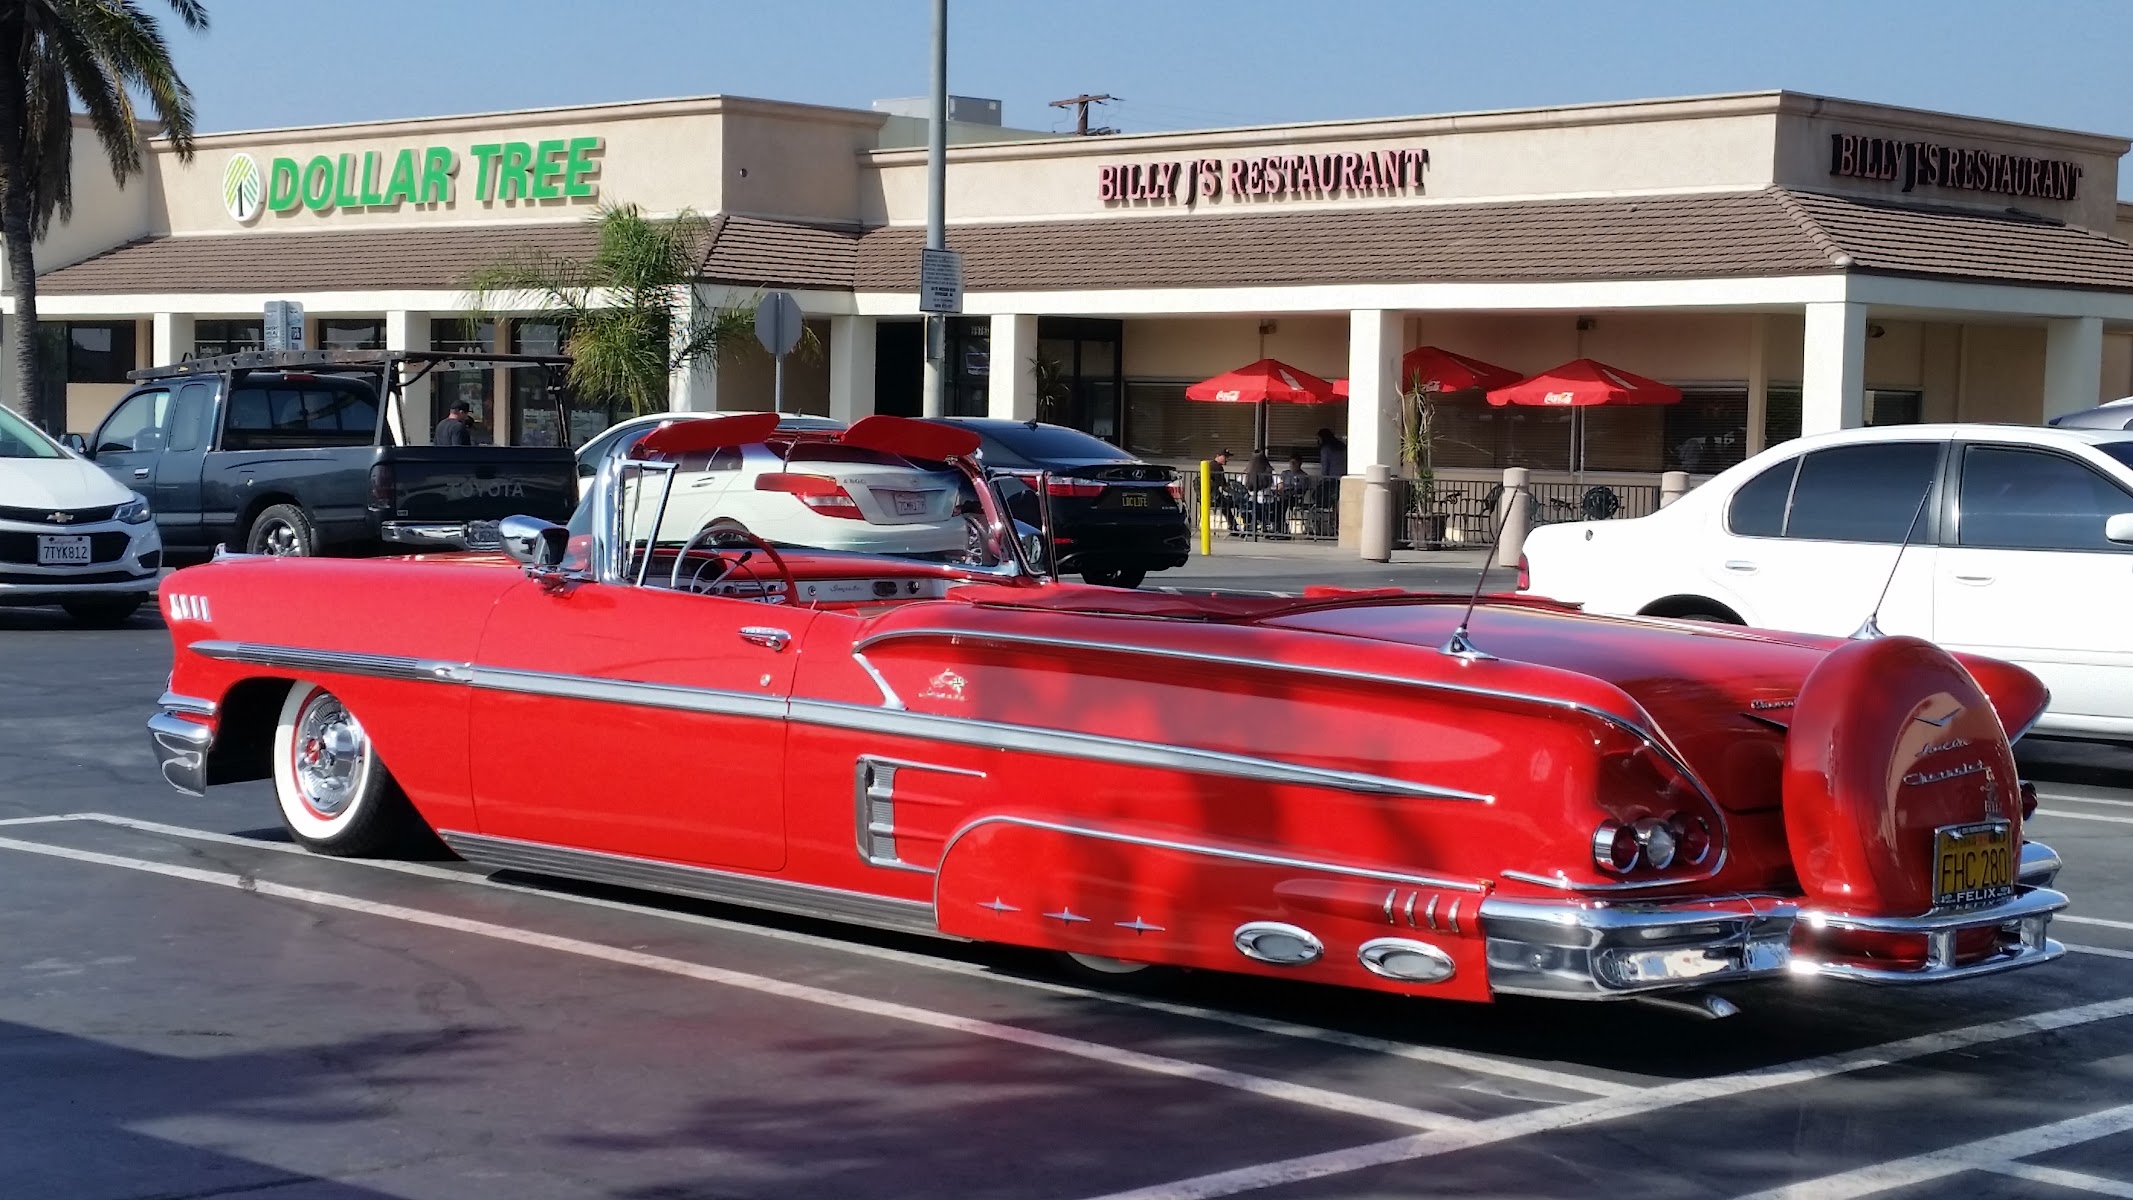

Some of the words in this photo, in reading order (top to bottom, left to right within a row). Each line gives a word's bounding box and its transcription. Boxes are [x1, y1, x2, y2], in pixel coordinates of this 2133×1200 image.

[268, 146, 456, 213] DOLLAR
[471, 136, 600, 202] TREE
[1098, 162, 1181, 201] BILLY
[1183, 157, 1222, 206] J'S
[1227, 149, 1428, 196] RESTAURANT
[1834, 133, 1906, 181] BILLY
[1905, 142, 1941, 192] J'S
[1946, 146, 2084, 200] RESTAURANT
[448, 481, 525, 498] TOYOTA
[43, 546, 88, 559] 7TYK812
[1941, 851, 1976, 892] FHC
[1981, 847, 2008, 888] 280
[1956, 888, 1996, 903] FELIX
